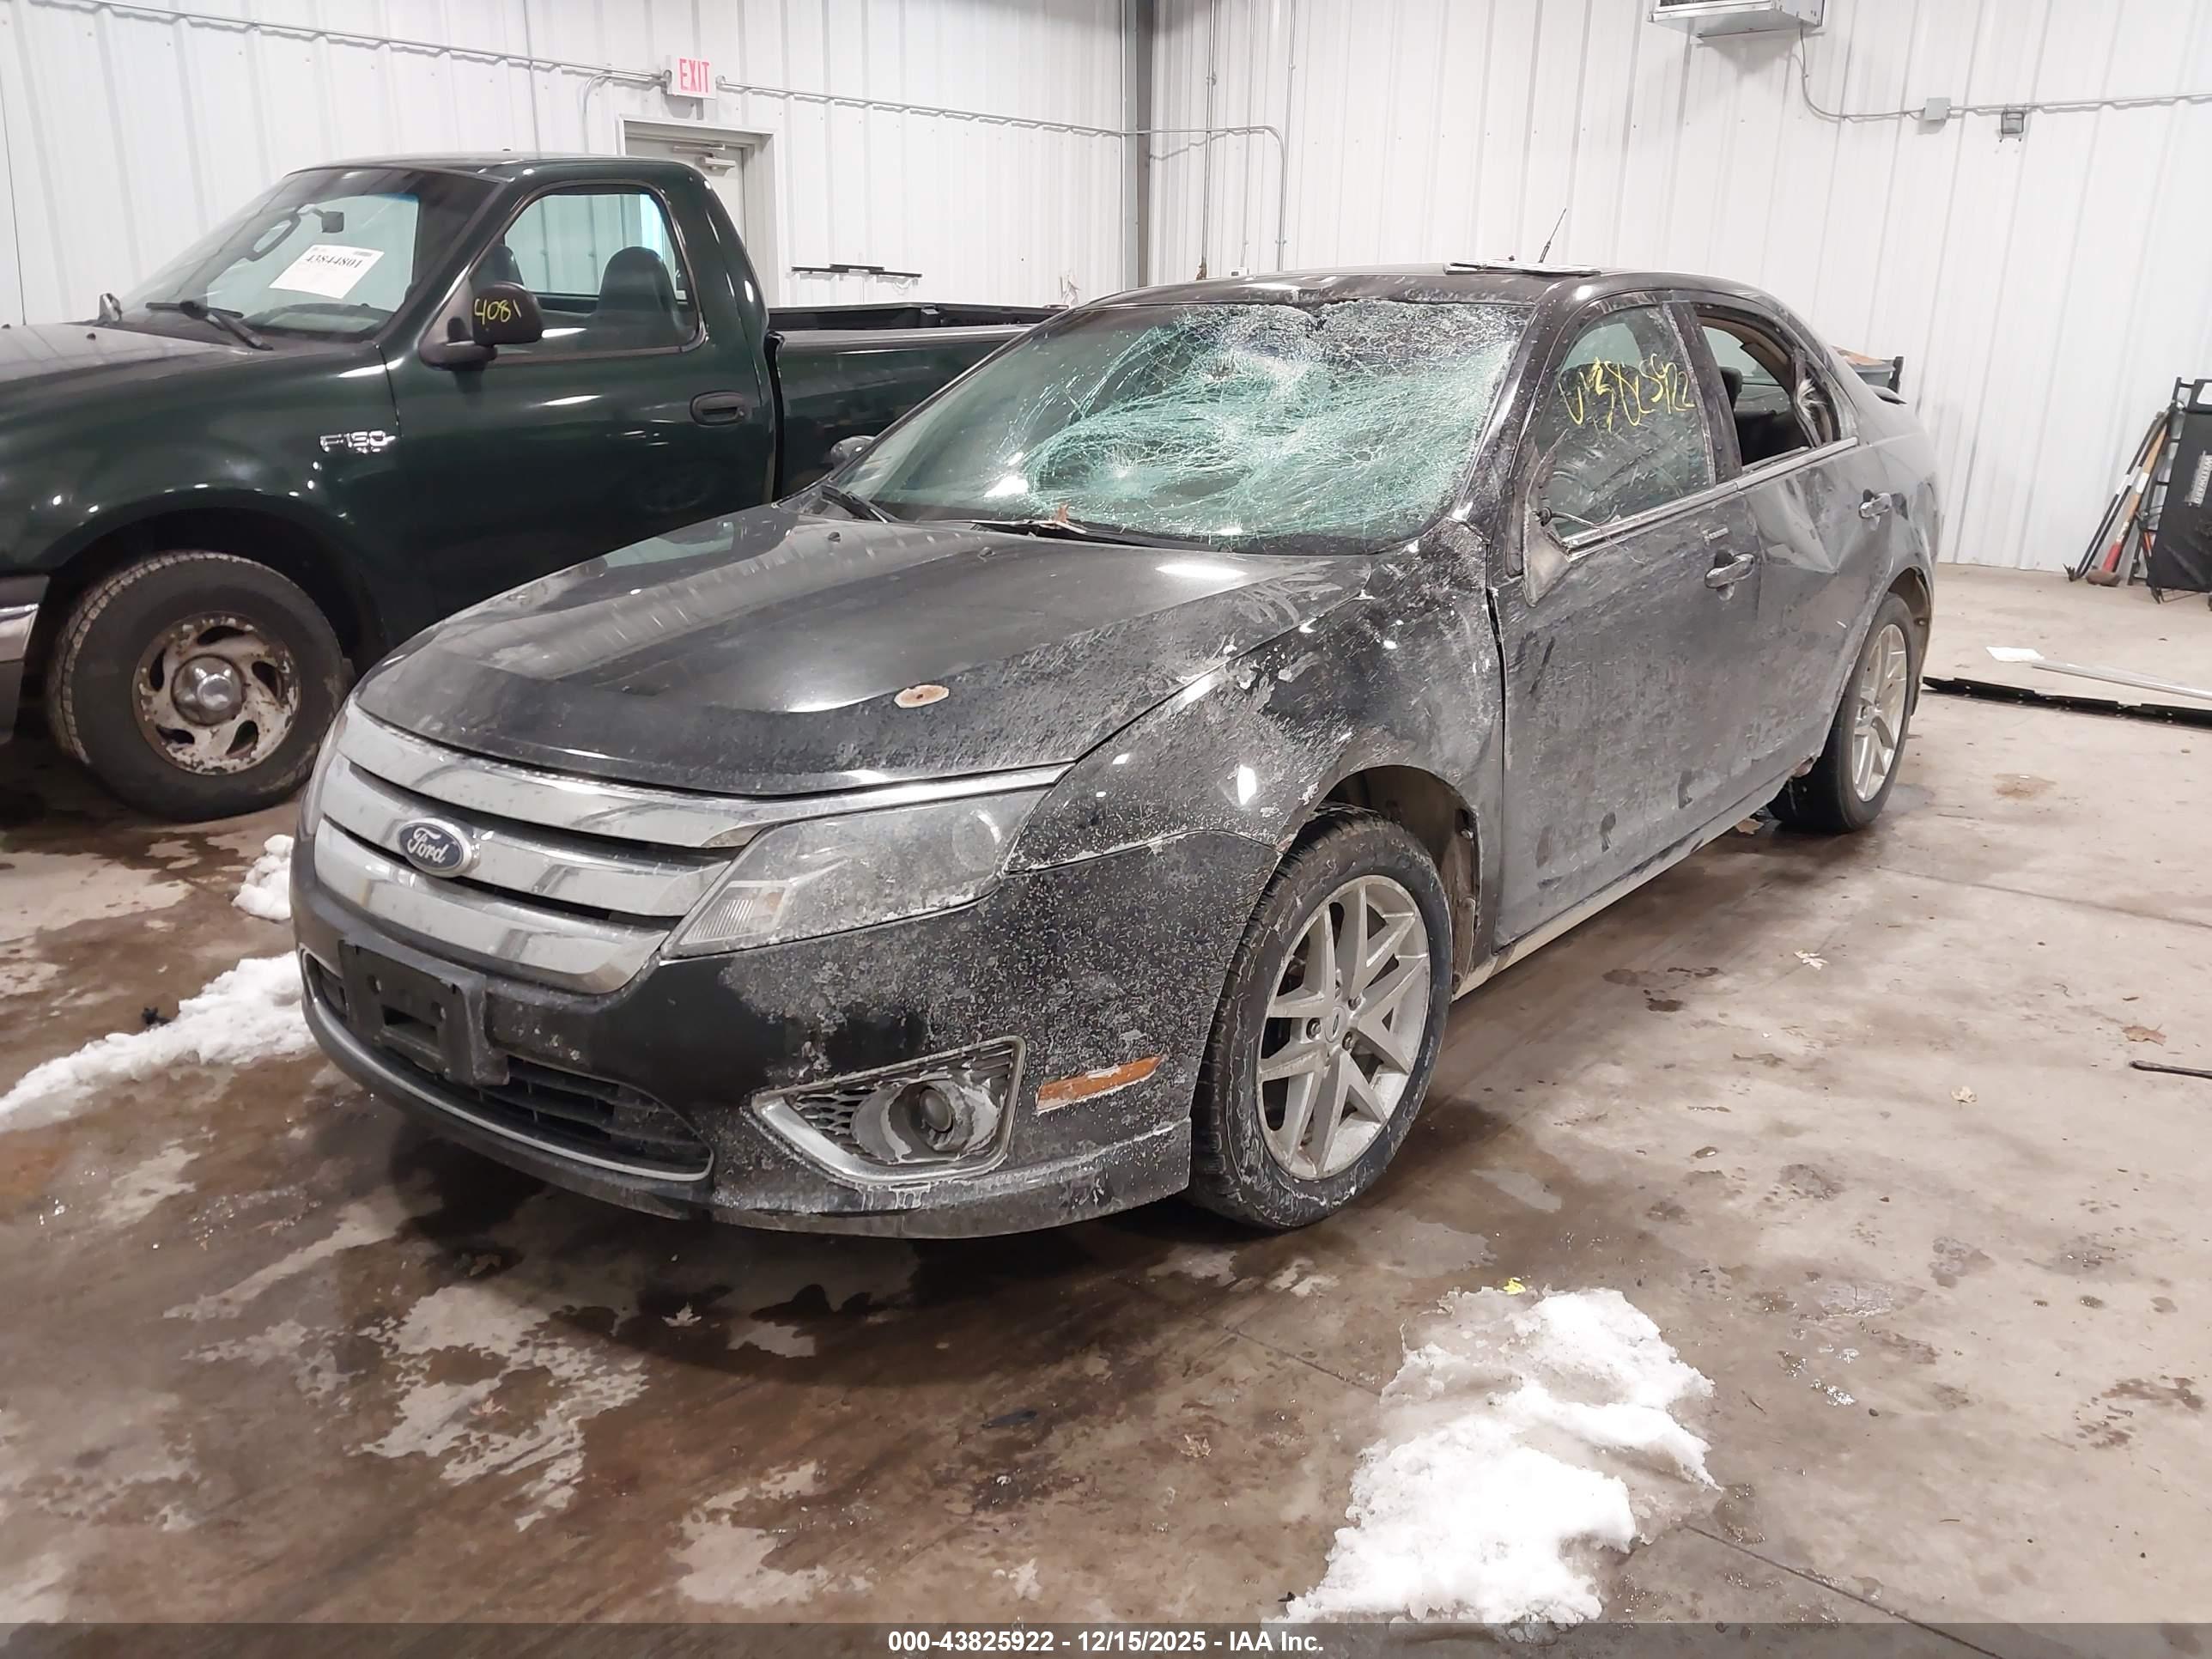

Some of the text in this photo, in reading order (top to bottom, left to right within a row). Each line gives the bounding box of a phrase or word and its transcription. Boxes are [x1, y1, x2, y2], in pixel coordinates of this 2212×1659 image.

[679, 58, 709, 94] EXIT
[306, 254, 363, 269] 43844801
[474, 298, 522, 325] 4081
[407, 827, 449, 864] Ford
